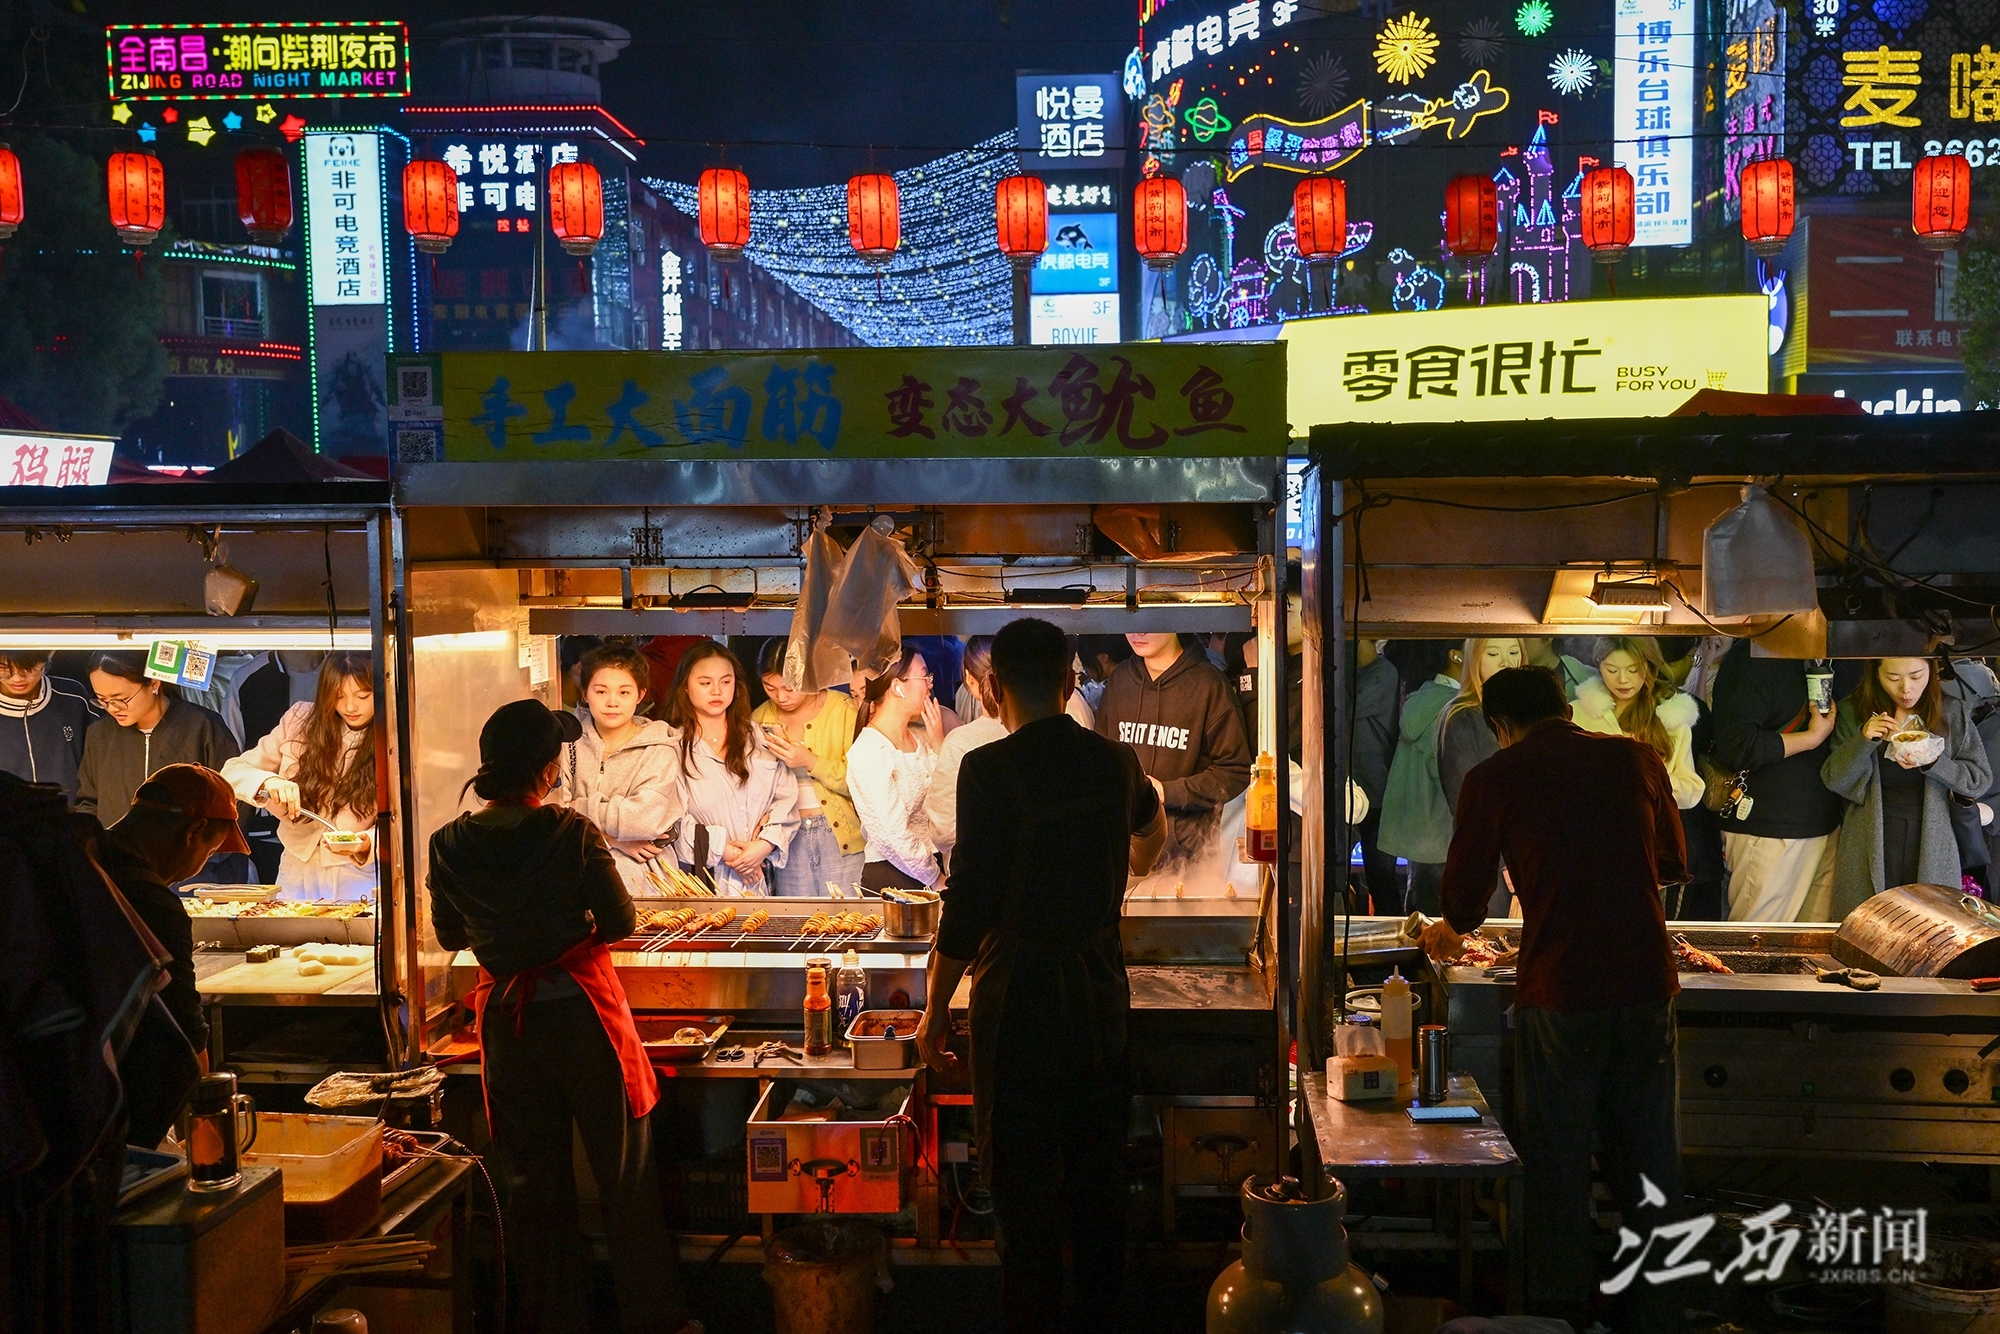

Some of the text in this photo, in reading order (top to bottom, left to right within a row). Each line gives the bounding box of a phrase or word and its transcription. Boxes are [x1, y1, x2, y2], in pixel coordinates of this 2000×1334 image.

[120, 71, 397, 90] ZIJING ROAD NIGHT MARKET
[1036, 85, 1104, 120] 悦曼
[1635, 20, 1672, 215] 博乐台球俱乐部
[1038, 122, 1105, 157] 酒店
[1848, 140, 1912, 170] TEL
[1933, 168, 1951, 218] 欢迎您
[331, 170, 361, 297] 非可电竞酒店
[1040, 252, 1109, 270] 虎鲸电竞
[1098, 277, 1111, 287] 3F
[1092, 300, 1112, 315] 3F
[1343, 337, 1602, 403] 零食很忙
[1615, 377, 1697, 392] FOR YOU
[1617, 365, 1669, 378] BUSY
[470, 352, 1248, 451] 手工大面筋 变态大鱿鱼
